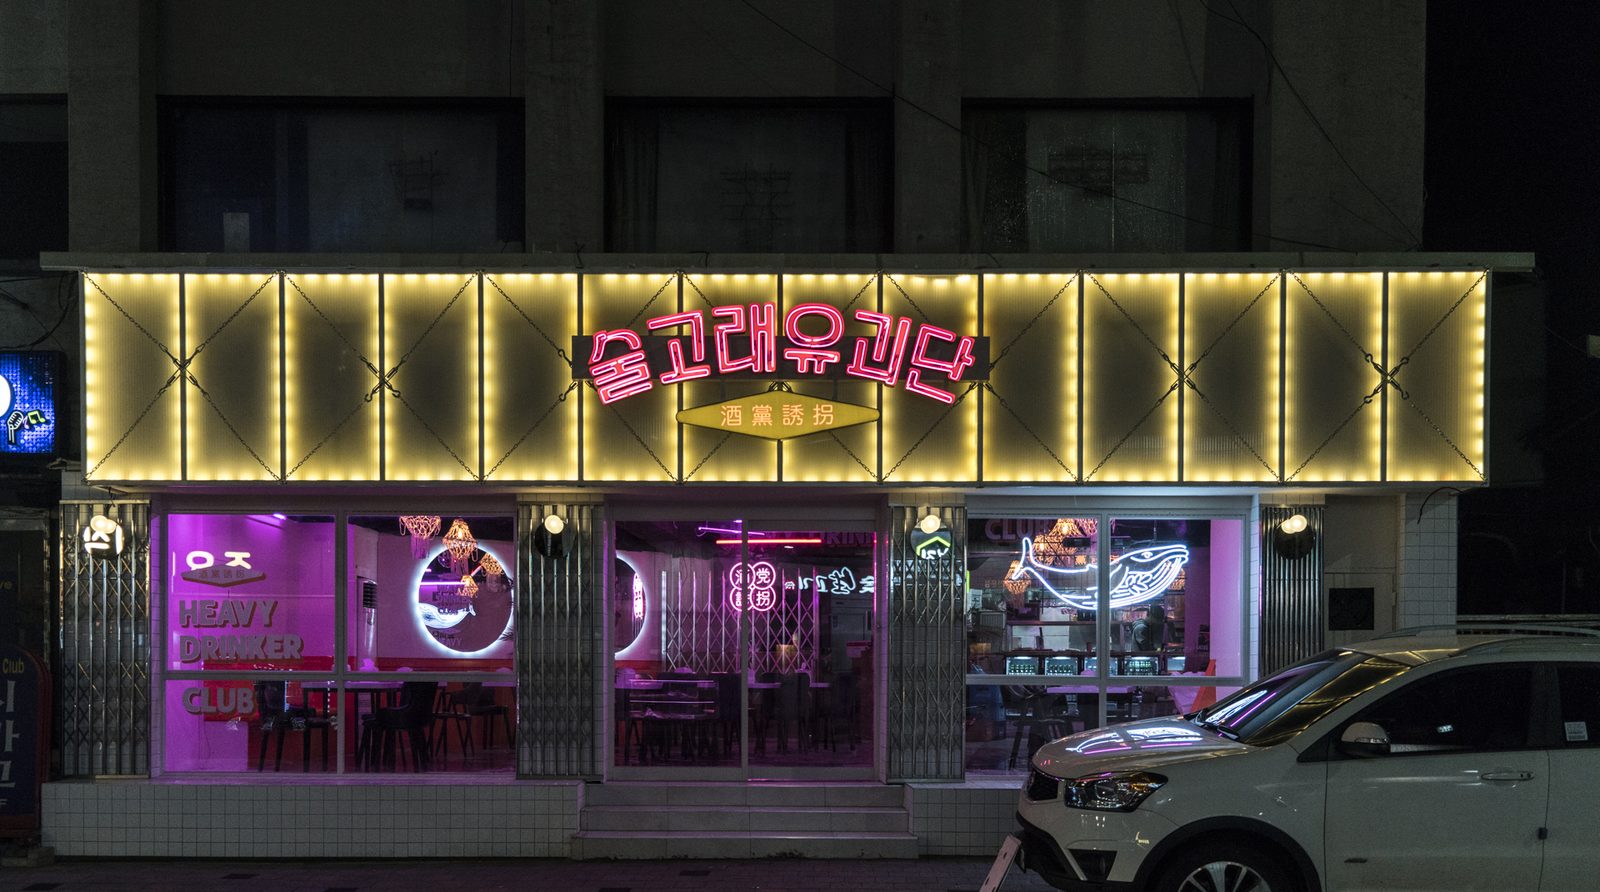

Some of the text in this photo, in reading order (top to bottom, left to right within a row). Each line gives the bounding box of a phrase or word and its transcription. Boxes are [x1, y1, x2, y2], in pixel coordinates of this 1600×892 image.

[588, 303, 976, 405] 술고래유괴단
[720, 404, 836, 427] 酒黨誘拐
[179, 600, 278, 628] HEAVY
[179, 635, 304, 663] DRINKER
[2, 657, 25, 674] Club
[182, 687, 258, 715] CLUB
